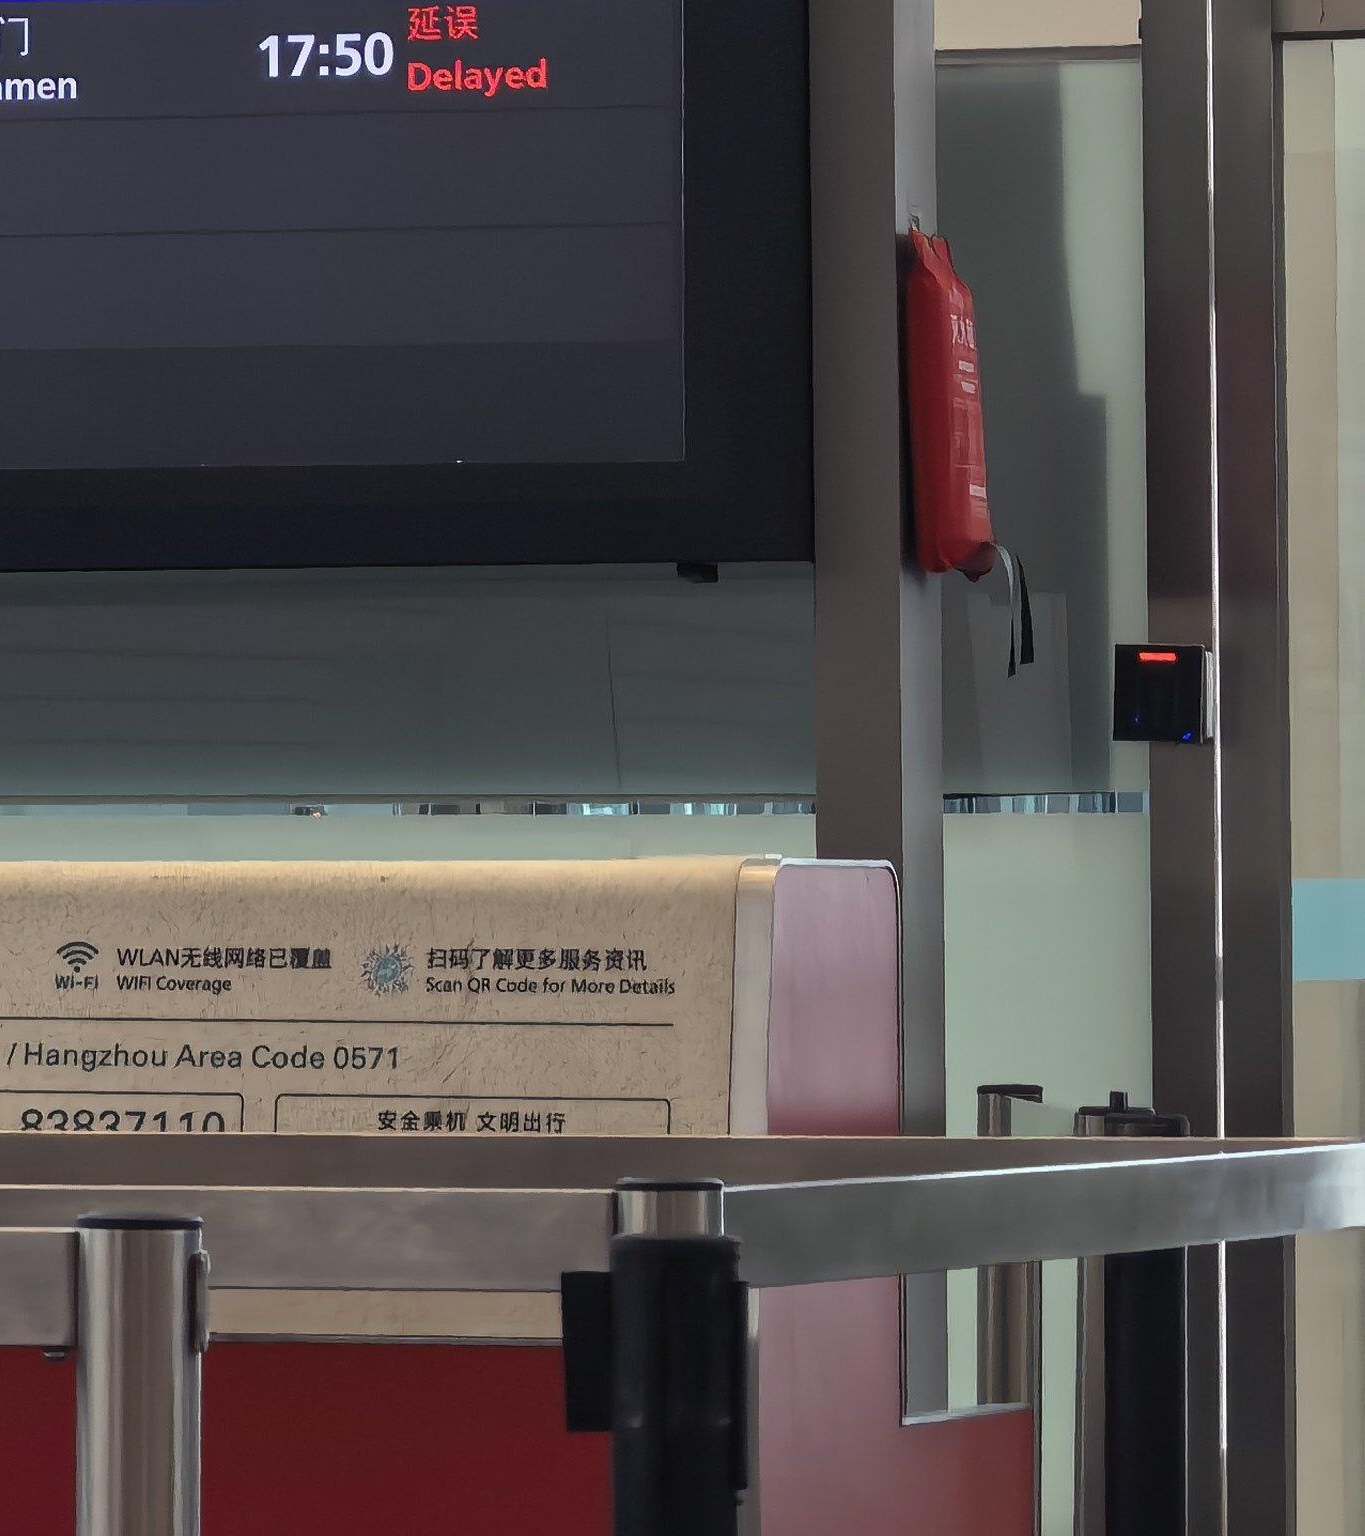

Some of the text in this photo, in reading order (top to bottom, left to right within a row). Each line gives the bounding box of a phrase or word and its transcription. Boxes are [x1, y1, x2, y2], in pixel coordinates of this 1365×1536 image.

[407, 4, 479, 43] 延误
[257, 31, 394, 79] 17:50
[407, 59, 547, 97] Delayed
[427, 947, 648, 971] 扫码了解更多服务资讯
[155, 975, 232, 994] Coverage
[426, 976, 676, 995] Scan QR Code for More Details
[24, 1043, 168, 1072] Hangzhou
[175, 1044, 242, 1069] Area
[252, 1045, 325, 1069] Code
[333, 1047, 400, 1070] 0571
[378, 1109, 566, 1134] 安全乘机 文明出行
